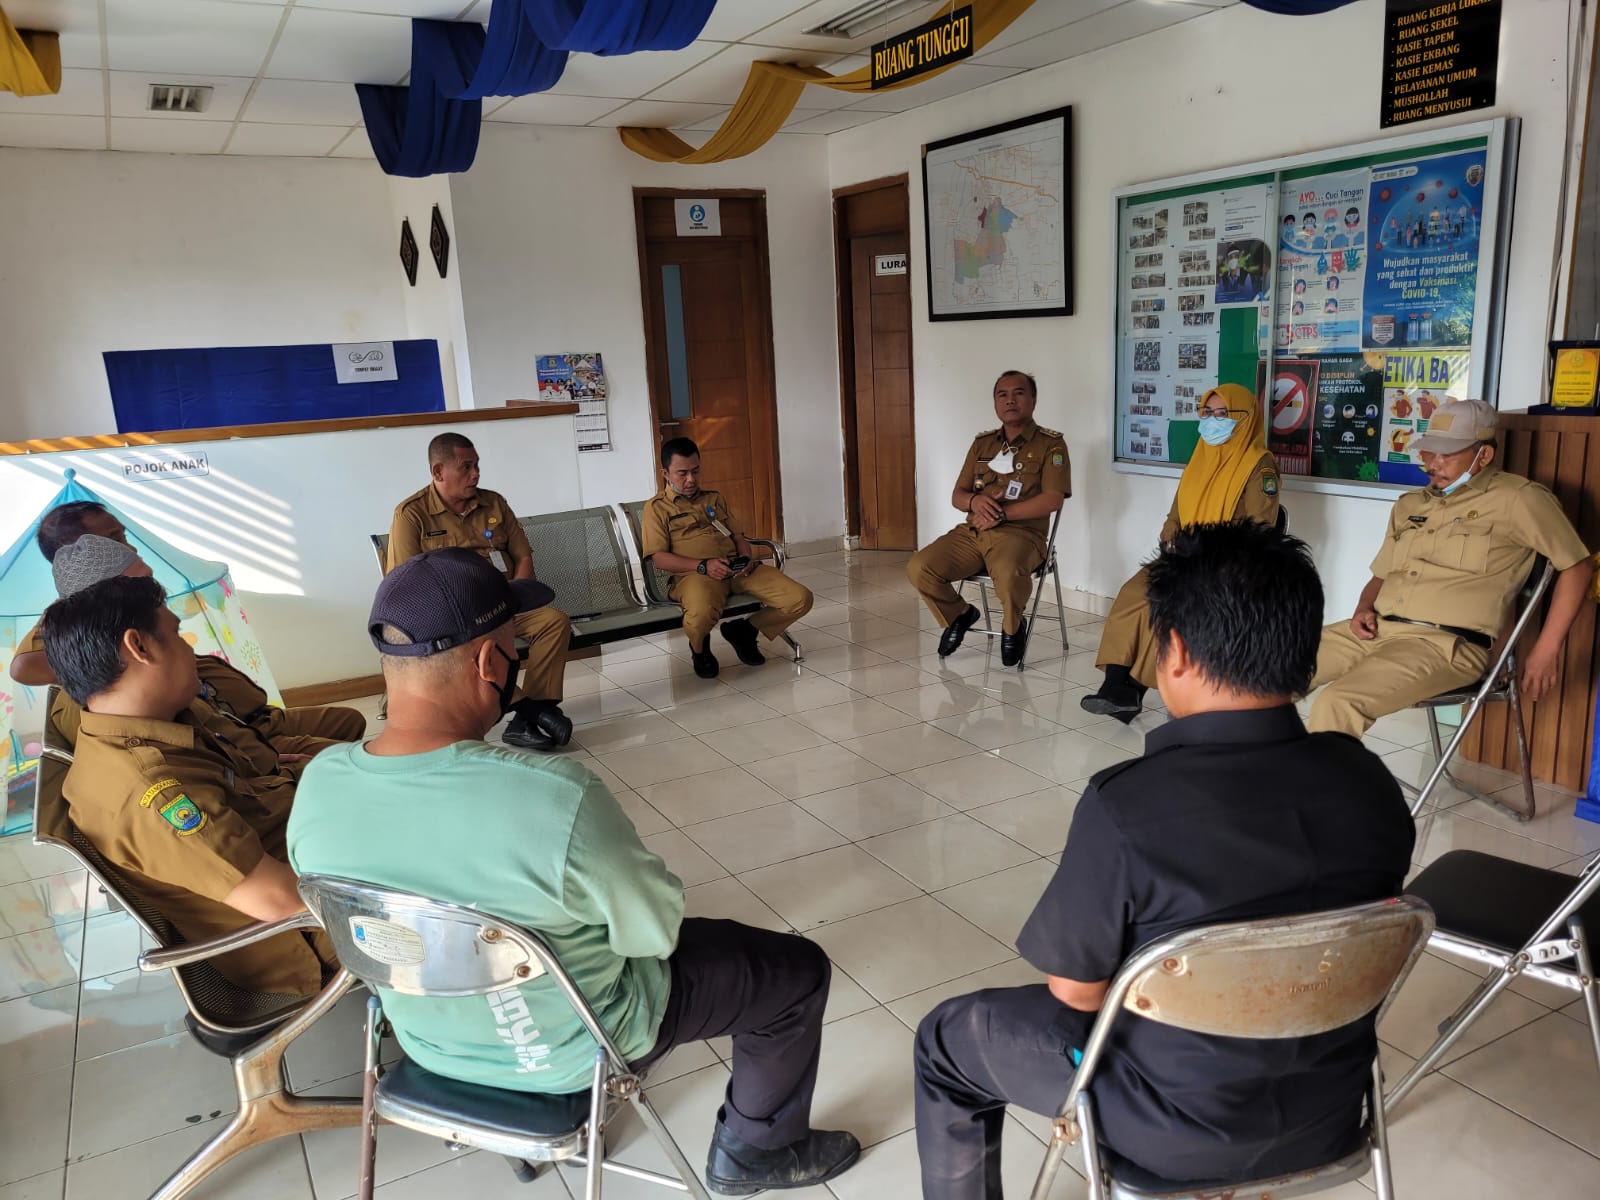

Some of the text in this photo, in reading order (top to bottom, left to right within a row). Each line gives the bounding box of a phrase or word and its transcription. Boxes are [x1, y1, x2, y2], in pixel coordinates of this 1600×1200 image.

[1397, 10, 1428, 27] RUANG
[1429, 2, 1457, 18] KERJA
[1399, 16, 1459, 40] RUANG SEKEL
[875, 16, 969, 80] RUANG TUNGGU
[1396, 31, 1454, 54] KASIE TAPEM
[1396, 43, 1460, 68] KASIE EKBANG
[1394, 67, 1477, 95] PELAYANAN UMUM
[1395, 59, 1454, 81] KASIE KEMAS
[1393, 97, 1472, 122] RUANG MENYUSUI
[1394, 88, 1449, 109] MUSHOLLAH
[1325, 189, 1339, 200] Cuci
[1340, 188, 1364, 198] Tangan
[1377, 262, 1474, 280] yang sehat dan produktif
[1383, 251, 1468, 269] Wujudkan masyarakat
[1389, 277, 1457, 290] dengan Vaksinasi
[1383, 356, 1425, 383] ETIKA
[1319, 385, 1366, 394] KESEHATAN
[124, 458, 205, 475] POJOK ANAK
